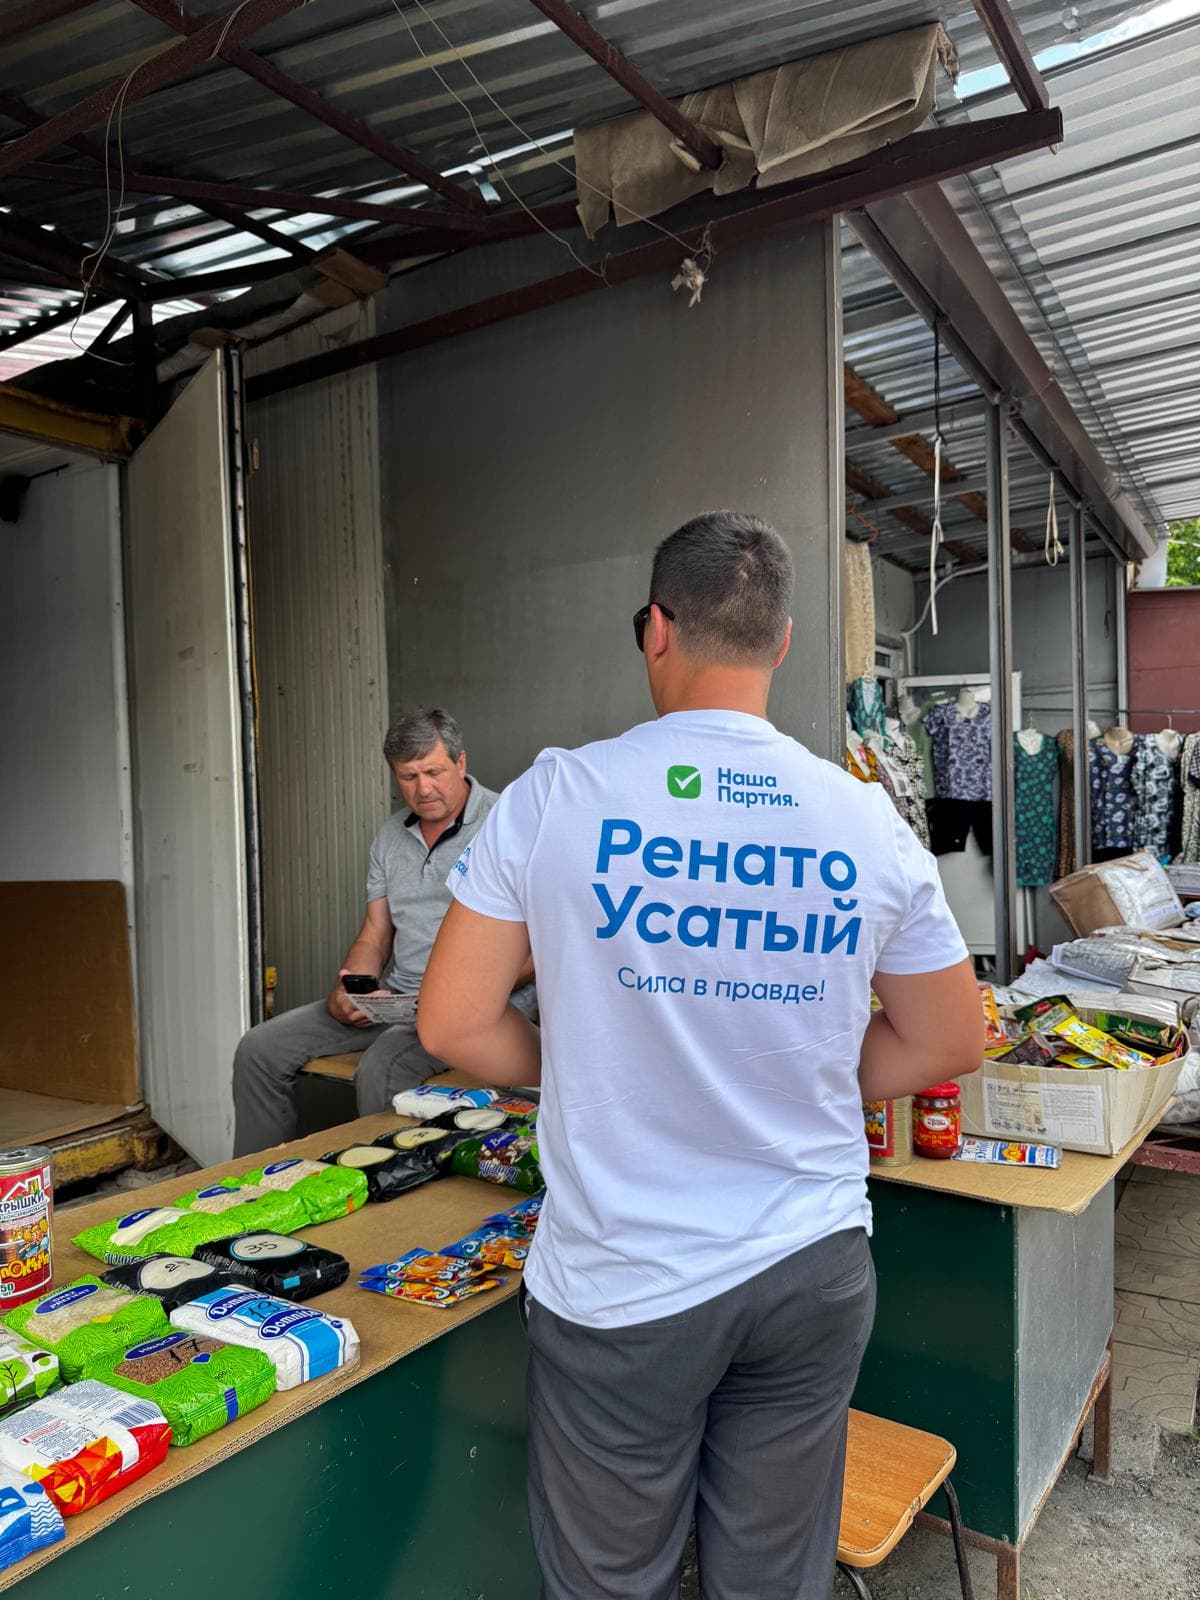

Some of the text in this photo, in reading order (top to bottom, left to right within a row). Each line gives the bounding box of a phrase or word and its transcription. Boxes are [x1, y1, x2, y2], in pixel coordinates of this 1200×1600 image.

[718, 768, 777, 788] Наша
[718, 786, 799, 807] Партия.
[596, 819, 857, 891] Ренато
[592, 883, 862, 955] Усатый
[617, 967, 825, 1004] Сила в правде!
[244, 1241, 278, 1255] 35
